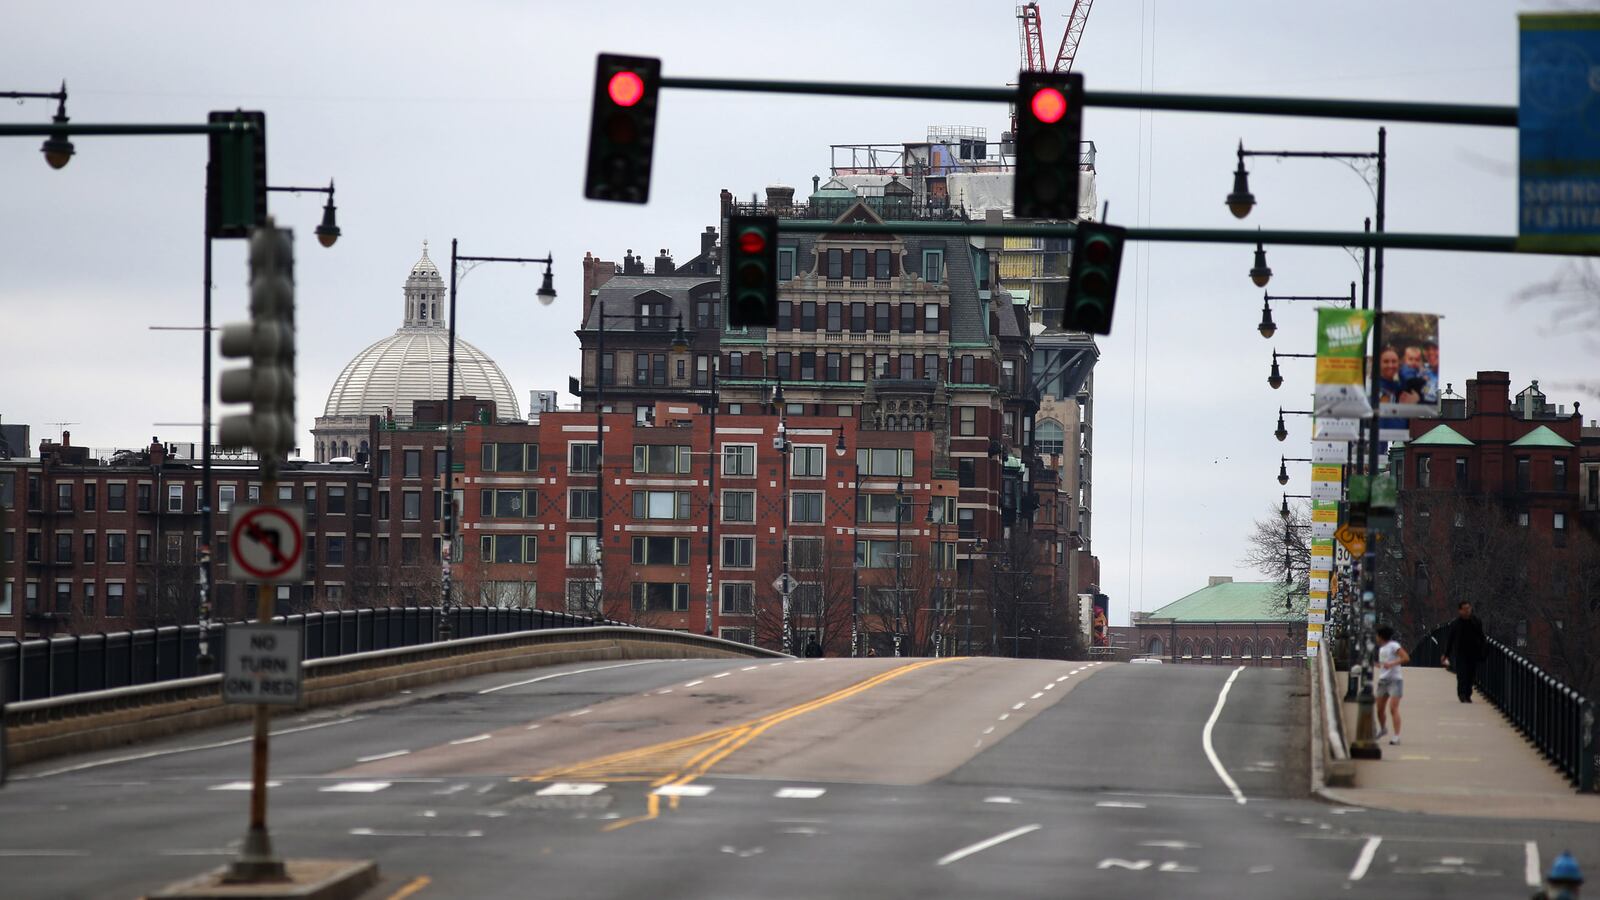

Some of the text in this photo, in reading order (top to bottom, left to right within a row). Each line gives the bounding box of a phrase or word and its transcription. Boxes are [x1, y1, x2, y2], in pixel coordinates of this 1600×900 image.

[1337, 548, 1350, 561] 30
[250, 633, 277, 651] NO
[239, 655, 288, 673] TURN
[226, 677, 296, 696] ON RED
